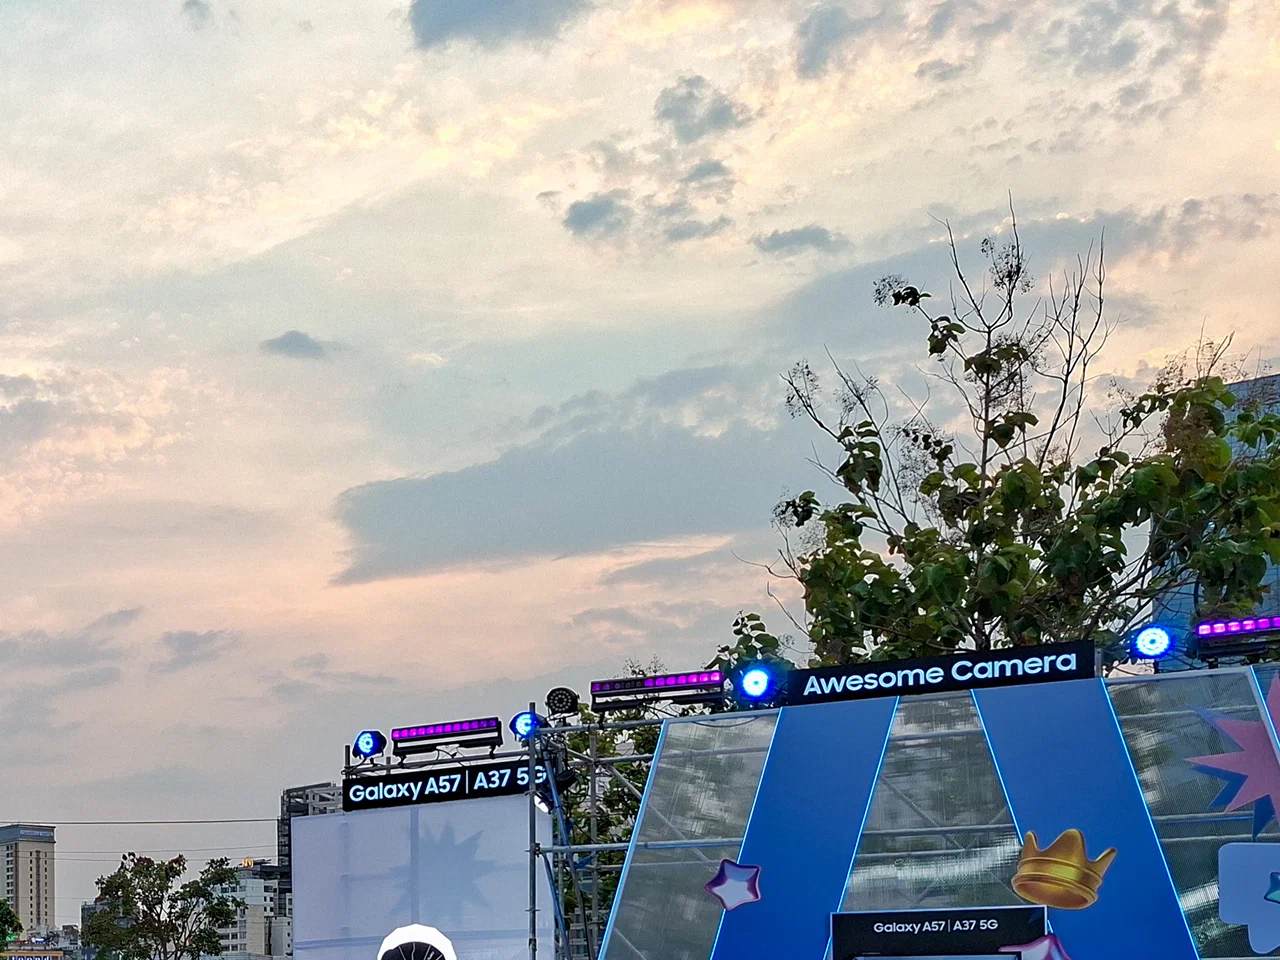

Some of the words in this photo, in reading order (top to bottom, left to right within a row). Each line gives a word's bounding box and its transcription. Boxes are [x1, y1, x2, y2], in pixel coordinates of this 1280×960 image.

[802, 666, 944, 696] Awesome
[951, 653, 1077, 681] Camera
[349, 781, 422, 802] Galaxy
[424, 774, 462, 795] A57
[473, 768, 511, 790] A37
[516, 765, 547, 785] 5G
[873, 922, 921, 934] Galaxy
[922, 920, 946, 932] A57
[953, 920, 977, 931] A37
[979, 919, 999, 930] 5G
